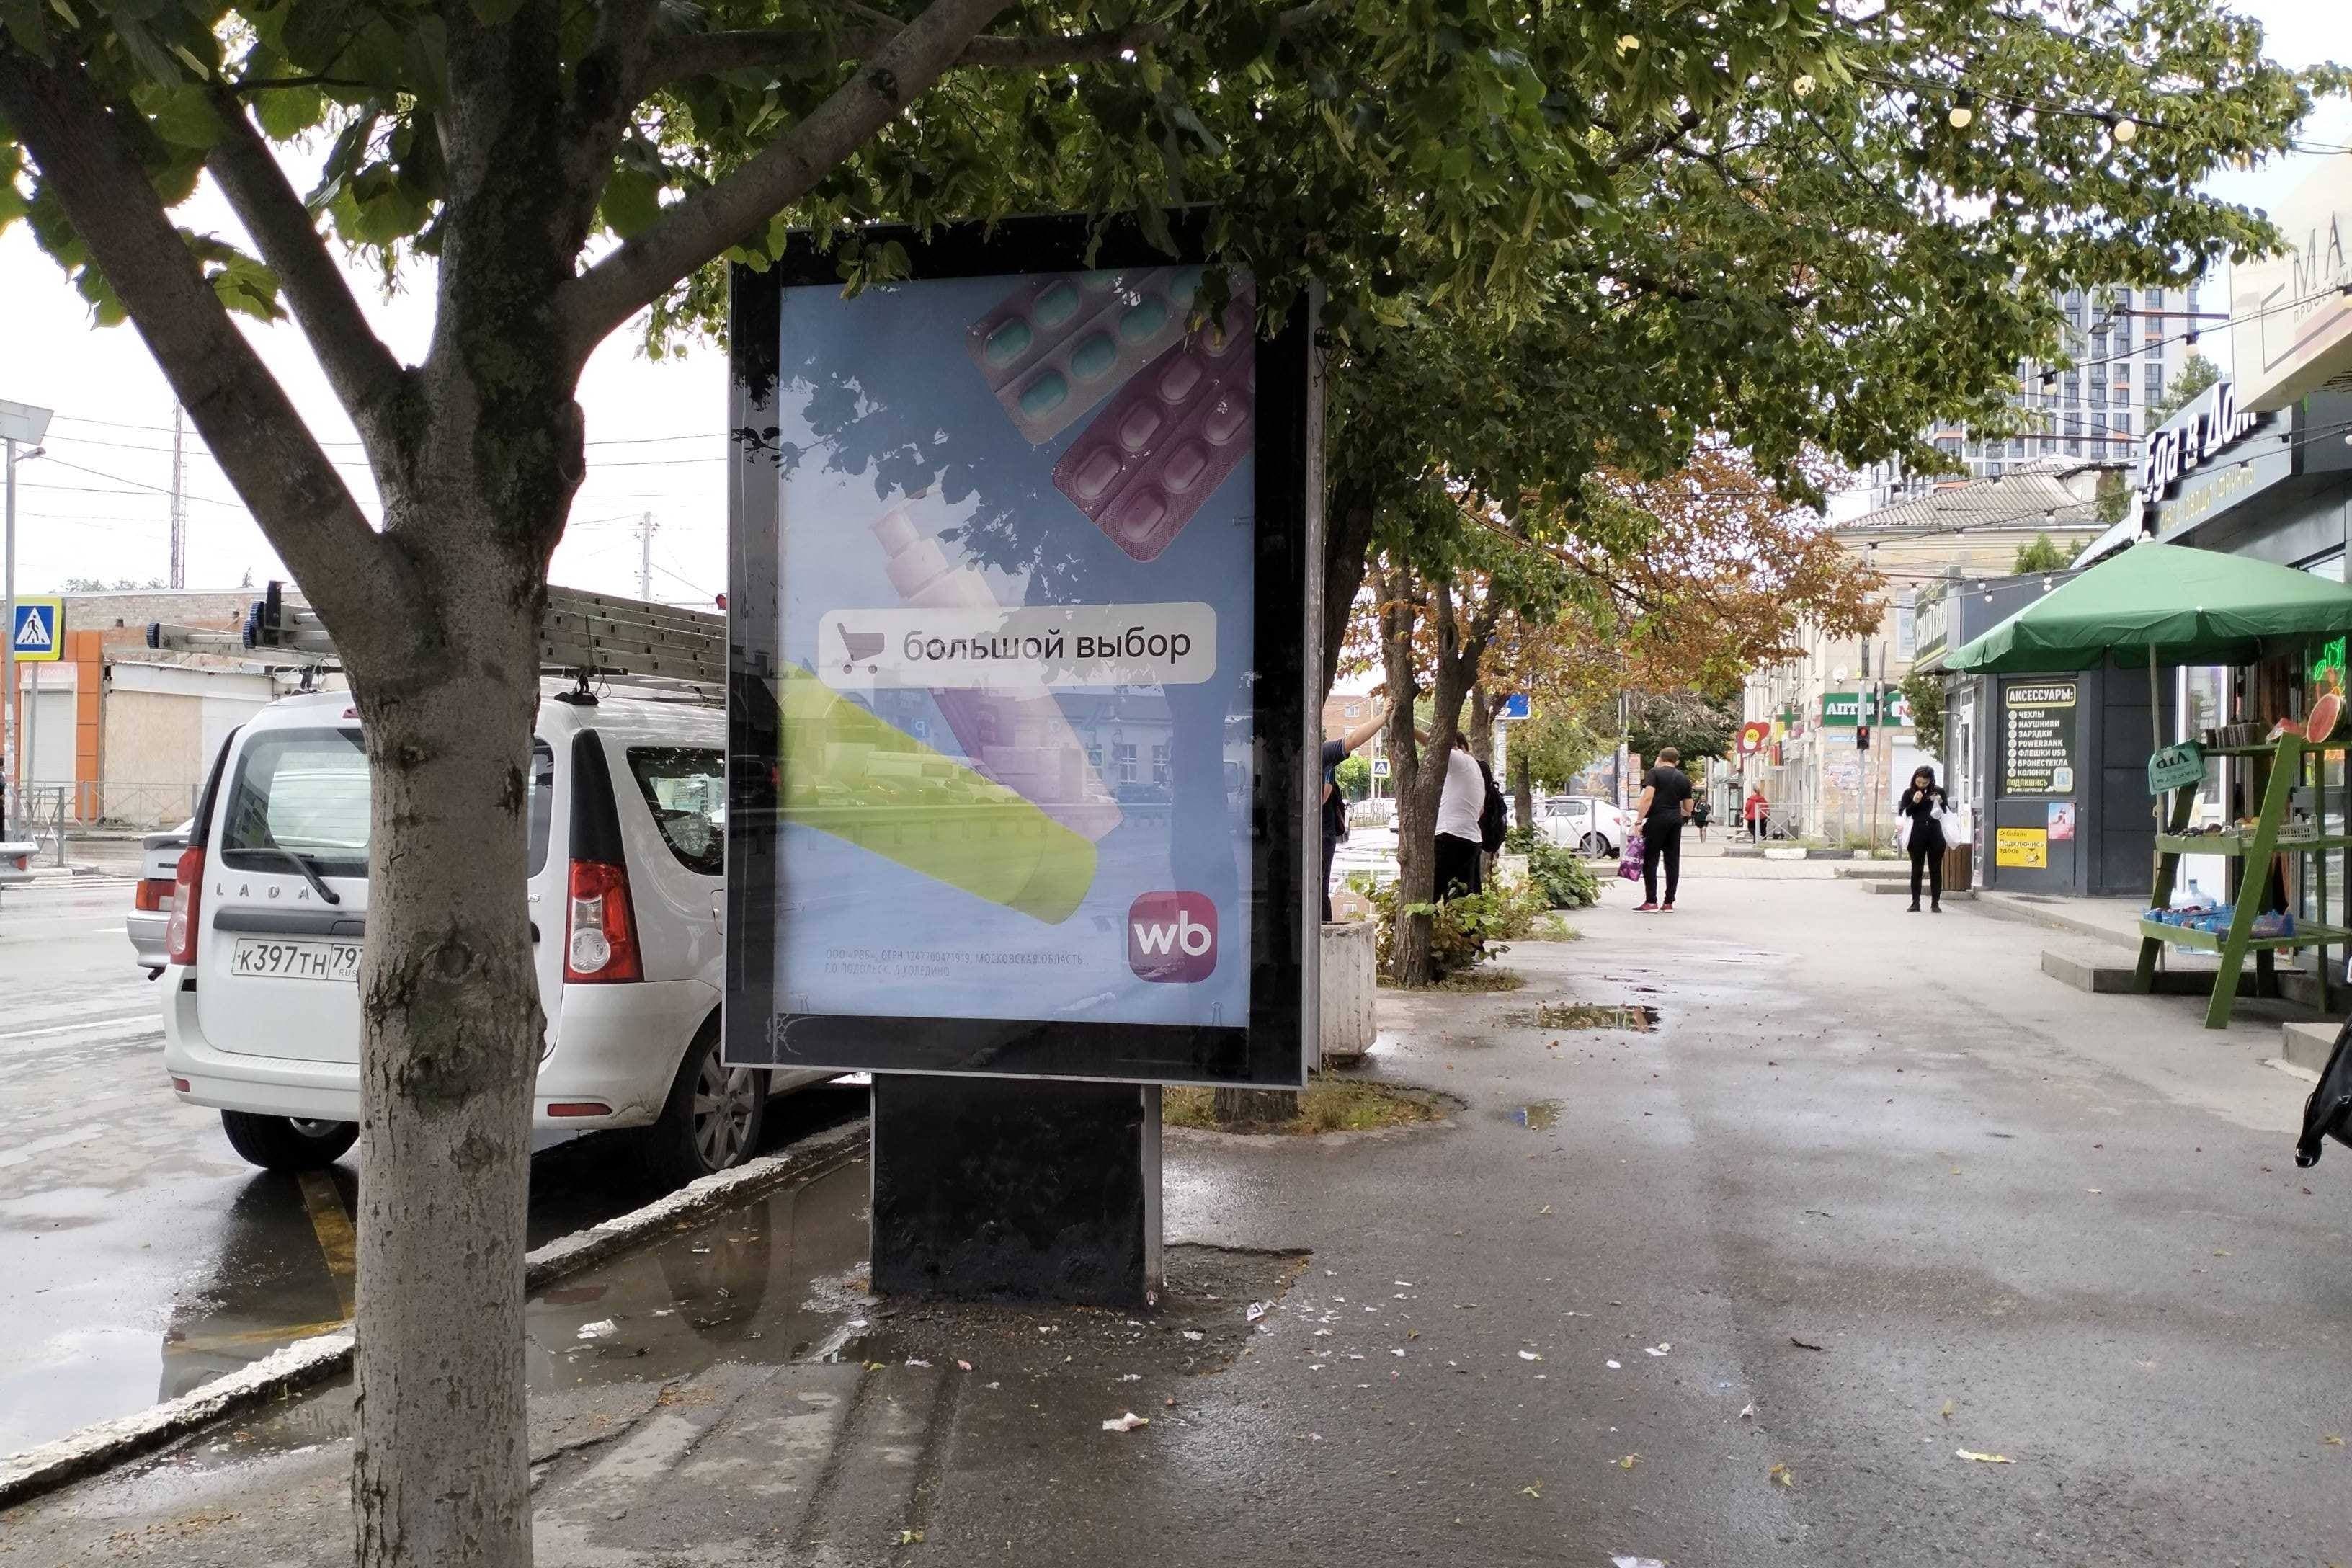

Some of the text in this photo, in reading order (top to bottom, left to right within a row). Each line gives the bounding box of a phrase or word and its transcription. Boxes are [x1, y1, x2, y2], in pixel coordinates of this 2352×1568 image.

[904, 625, 1191, 664] большой выбор
[2008, 688, 2074, 703] АКСЕССУАРЫ:
[2018, 710, 2044, 719] ЧЕХЛЫ
[2018, 720, 2060, 729] НАУШНИКИ
[2018, 730, 2052, 739] ЗАРЯДКИ
[2018, 749, 2051, 757] ФЛЕШКИ
[2006, 778, 2048, 787] ПОДПИШИСЬ
[216, 883, 310, 900] LADA
[1133, 910, 1211, 956] wb
[240, 945, 326, 975] К397ТН
[881, 949, 903, 961] ОГРН
[976, 953, 1038, 964] МОСКОВСКАЯ
